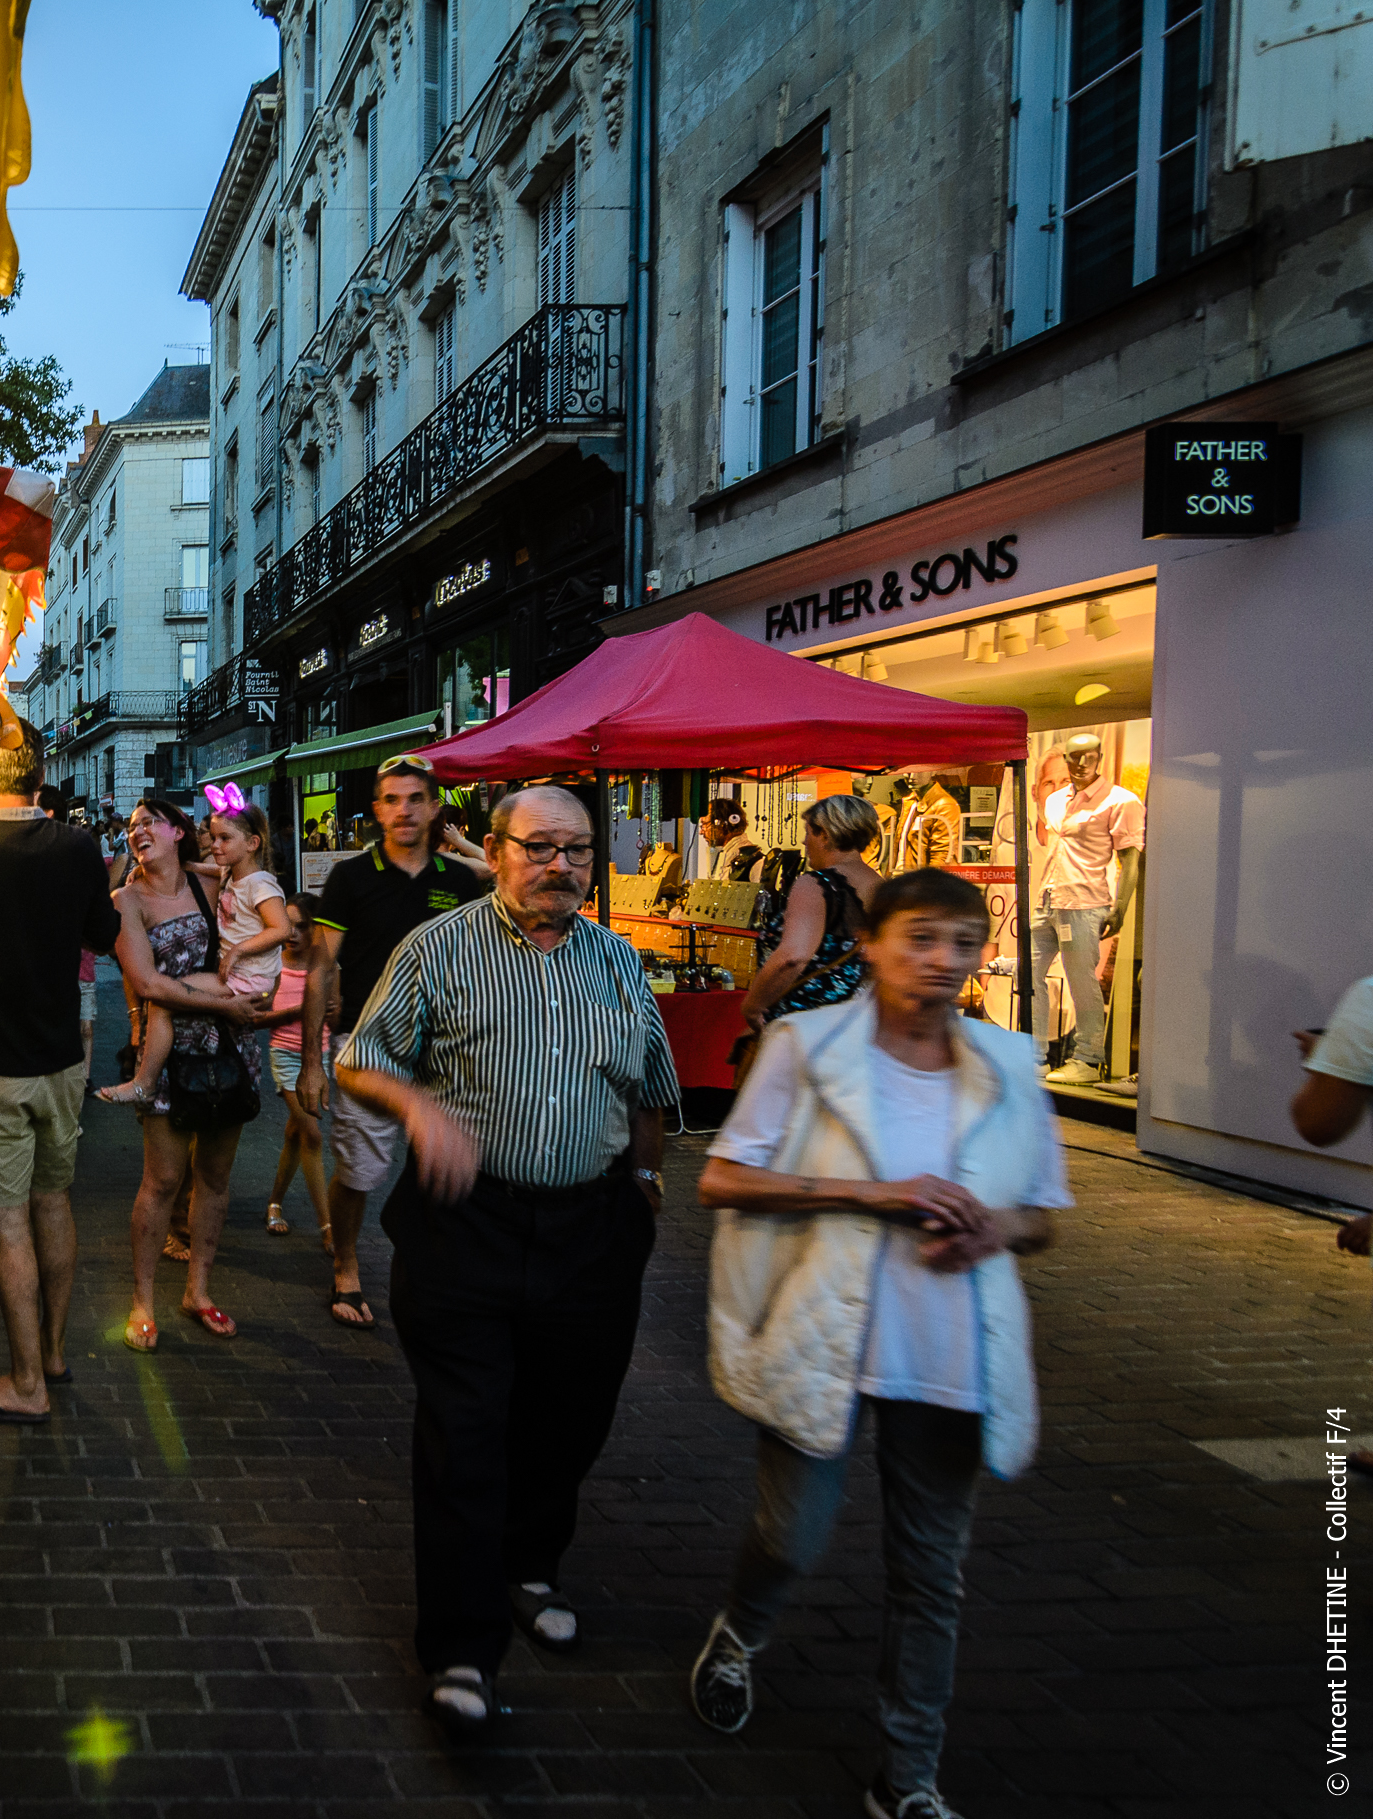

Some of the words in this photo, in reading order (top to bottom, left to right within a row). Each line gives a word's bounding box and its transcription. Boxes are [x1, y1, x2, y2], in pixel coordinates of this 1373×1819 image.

[1175, 440, 1267, 461] FATHER
[1211, 467, 1230, 487] &
[1186, 494, 1254, 515] SONS
[765, 579, 875, 641] FATHER
[878, 571, 903, 611] &
[910, 534, 1018, 602] SONS
[245, 671, 279, 679] Fournil
[256, 700, 278, 722] N
